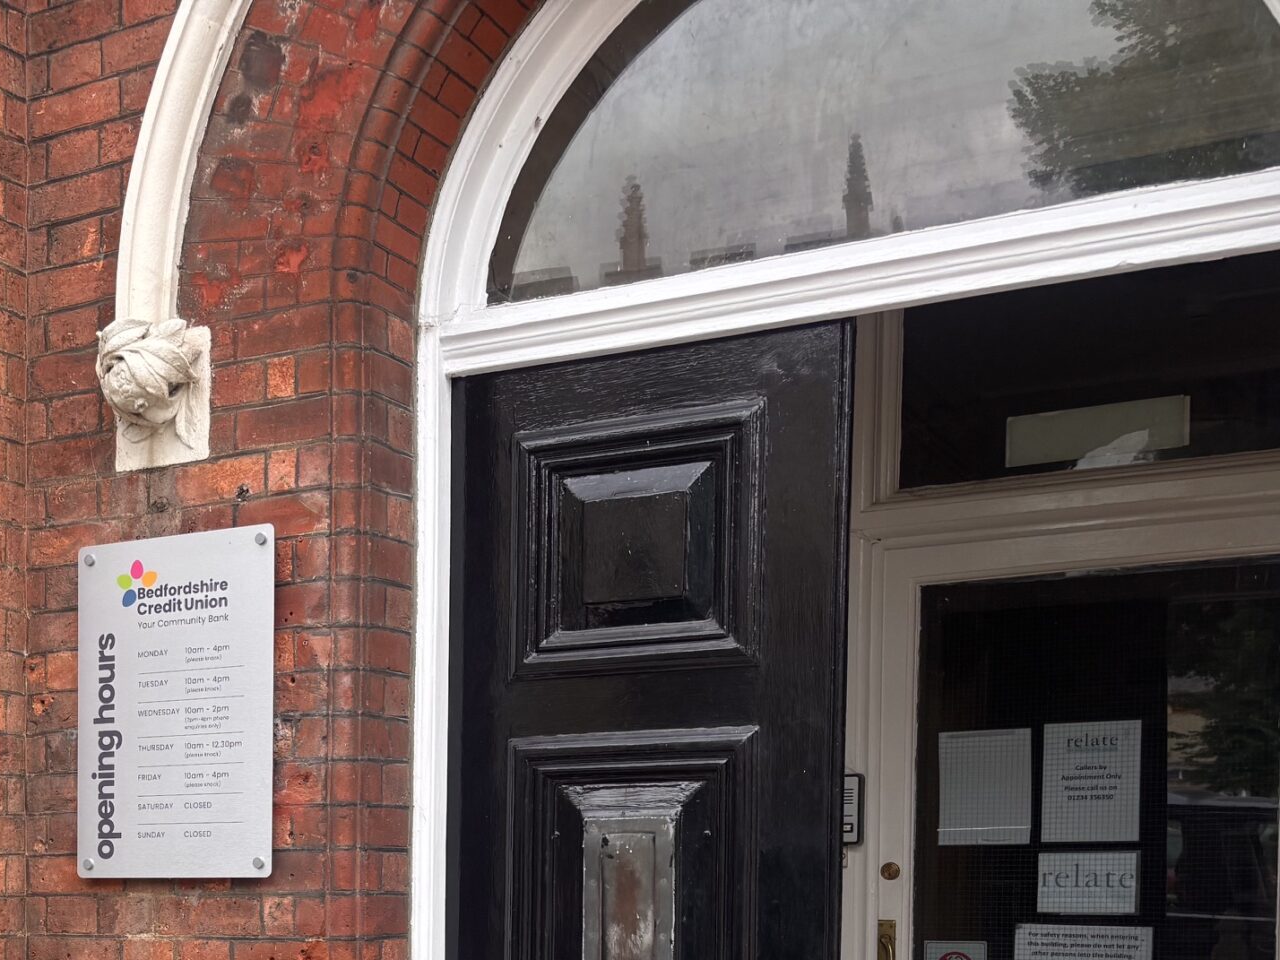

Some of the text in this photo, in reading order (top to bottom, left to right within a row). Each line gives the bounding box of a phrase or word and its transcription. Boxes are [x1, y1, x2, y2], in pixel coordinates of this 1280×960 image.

[138, 578, 228, 600] Bedfordshire
[137, 595, 228, 615] Credit Union
[138, 613, 229, 630] Your Community Bank
[138, 644, 230, 658] MONDAY 10am 4pm
[139, 675, 230, 688] TUESDAY 10am 4pm
[138, 708, 180, 717] WEDNESDAY
[213, 705, 229, 713] 2pm
[92, 633, 122, 860] opening hours
[139, 740, 243, 752] THURSDAY 10am 12.30pm
[1067, 733, 1118, 748] relate
[212, 771, 229, 779] 4pm
[1062, 774, 1105, 782] Appointment
[138, 801, 212, 811] SATURDAY CLOSED
[138, 830, 212, 839] SUNDAY CLOSED
[1041, 864, 1136, 889] relate
